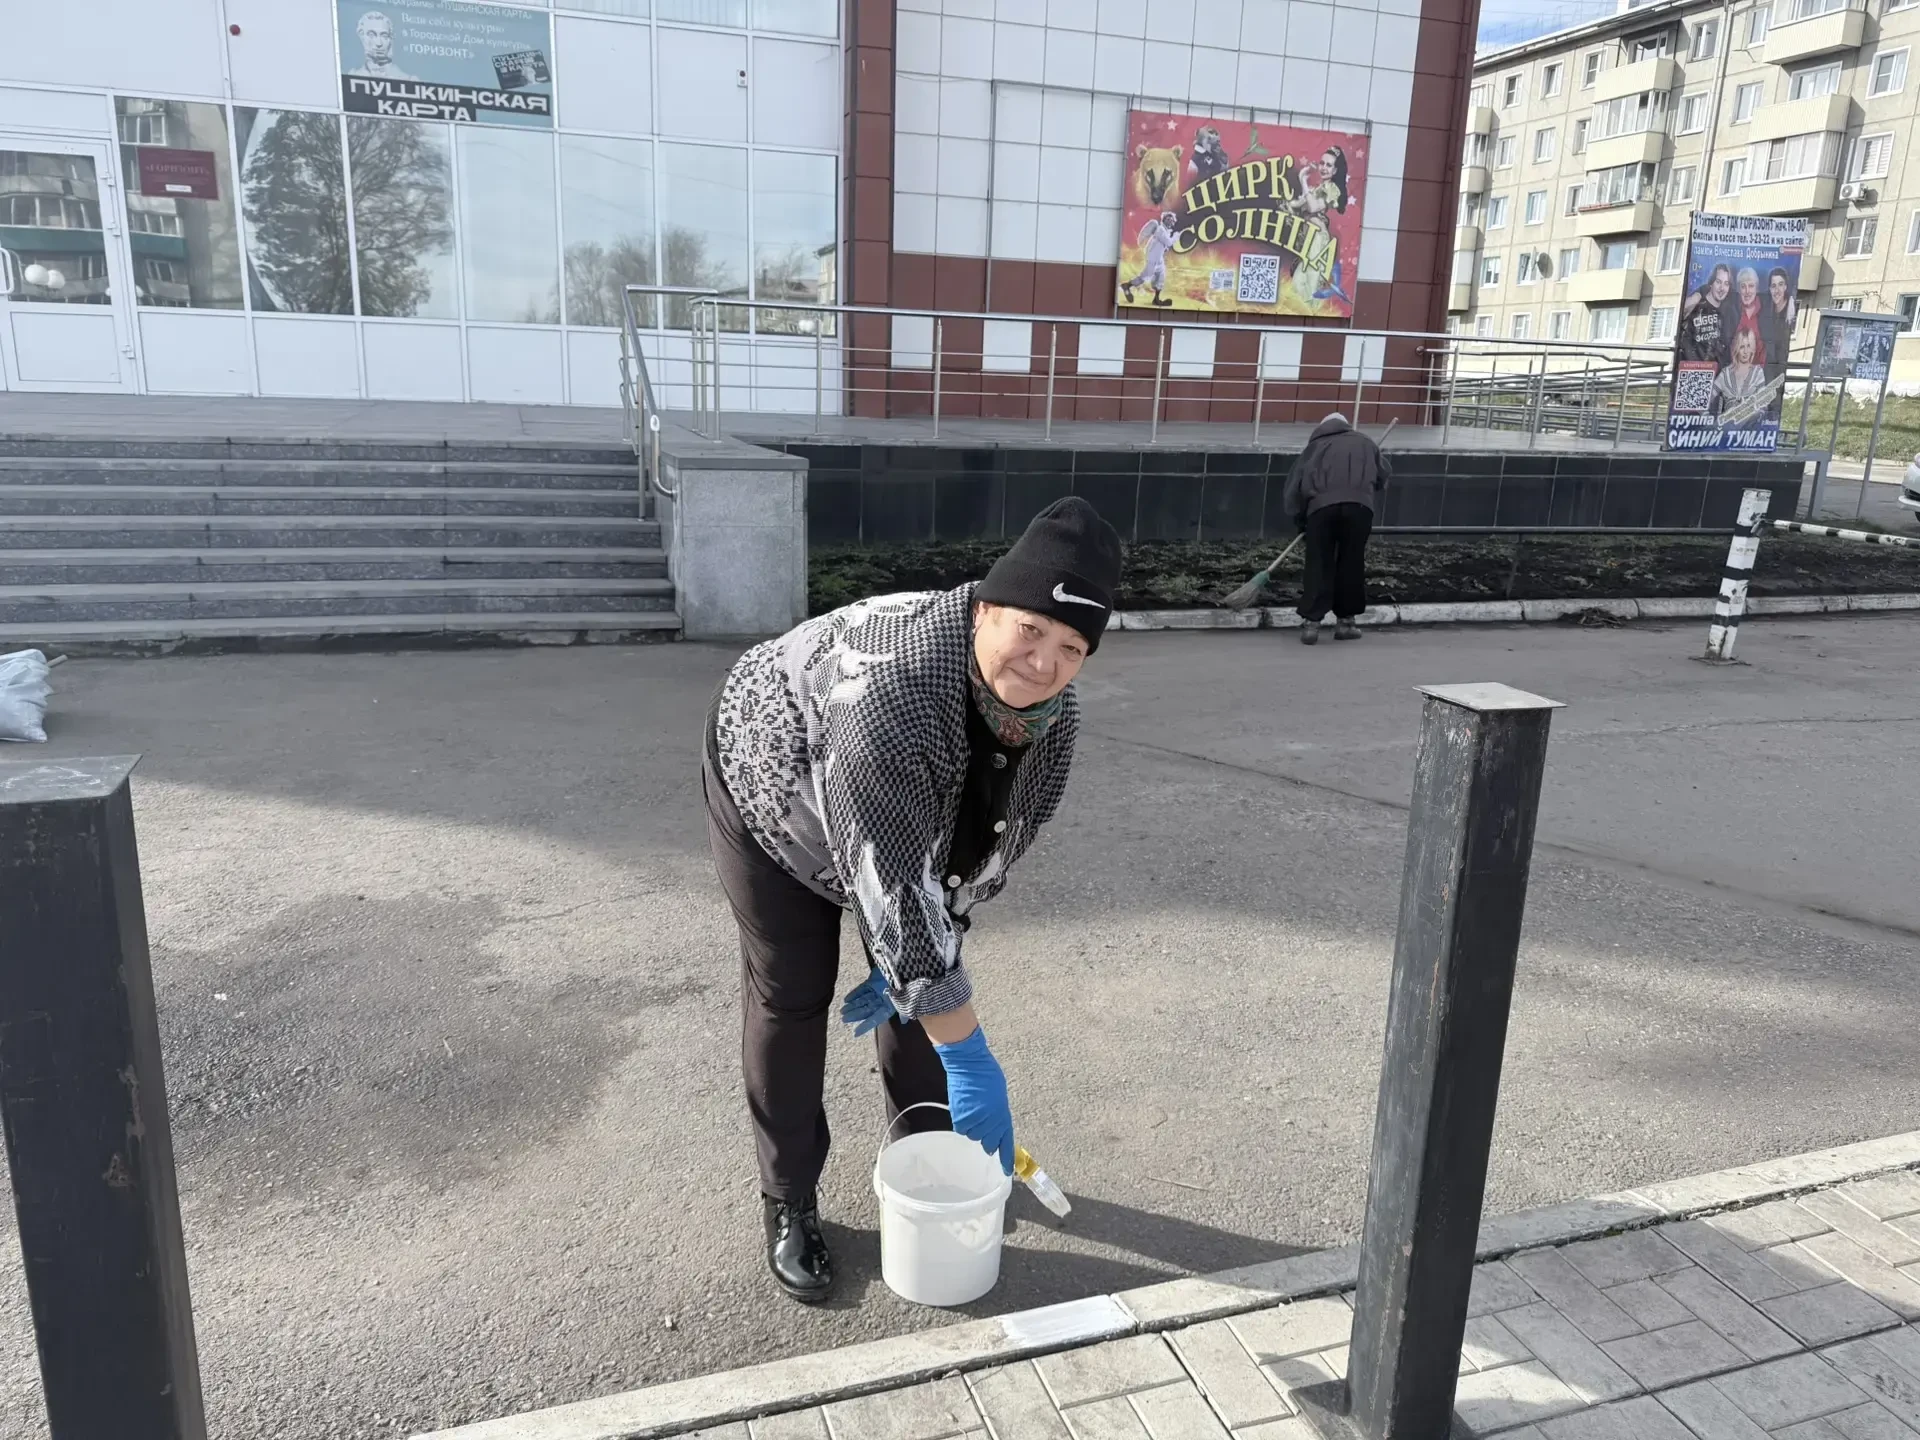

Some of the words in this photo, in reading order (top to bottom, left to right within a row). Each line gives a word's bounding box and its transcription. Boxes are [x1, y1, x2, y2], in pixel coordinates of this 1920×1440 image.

[410, 28, 461, 42] Городской
[463, 34, 485, 45] Дом
[403, 43, 475, 59] «ГОРИЗОНТ»
[350, 79, 547, 112] ПУШКИНСКАЯ
[378, 100, 471, 121] КАРТА
[1182, 155, 1294, 215] ЦИРК
[1740, 216, 1774, 231] ГОРИЗОНТ
[1172, 208, 1338, 281] СОЛНЦА
[1670, 414, 1715, 428] группа
[1668, 427, 1723, 448] СИНИЙ
[1726, 430, 1777, 447] ТУМАН
